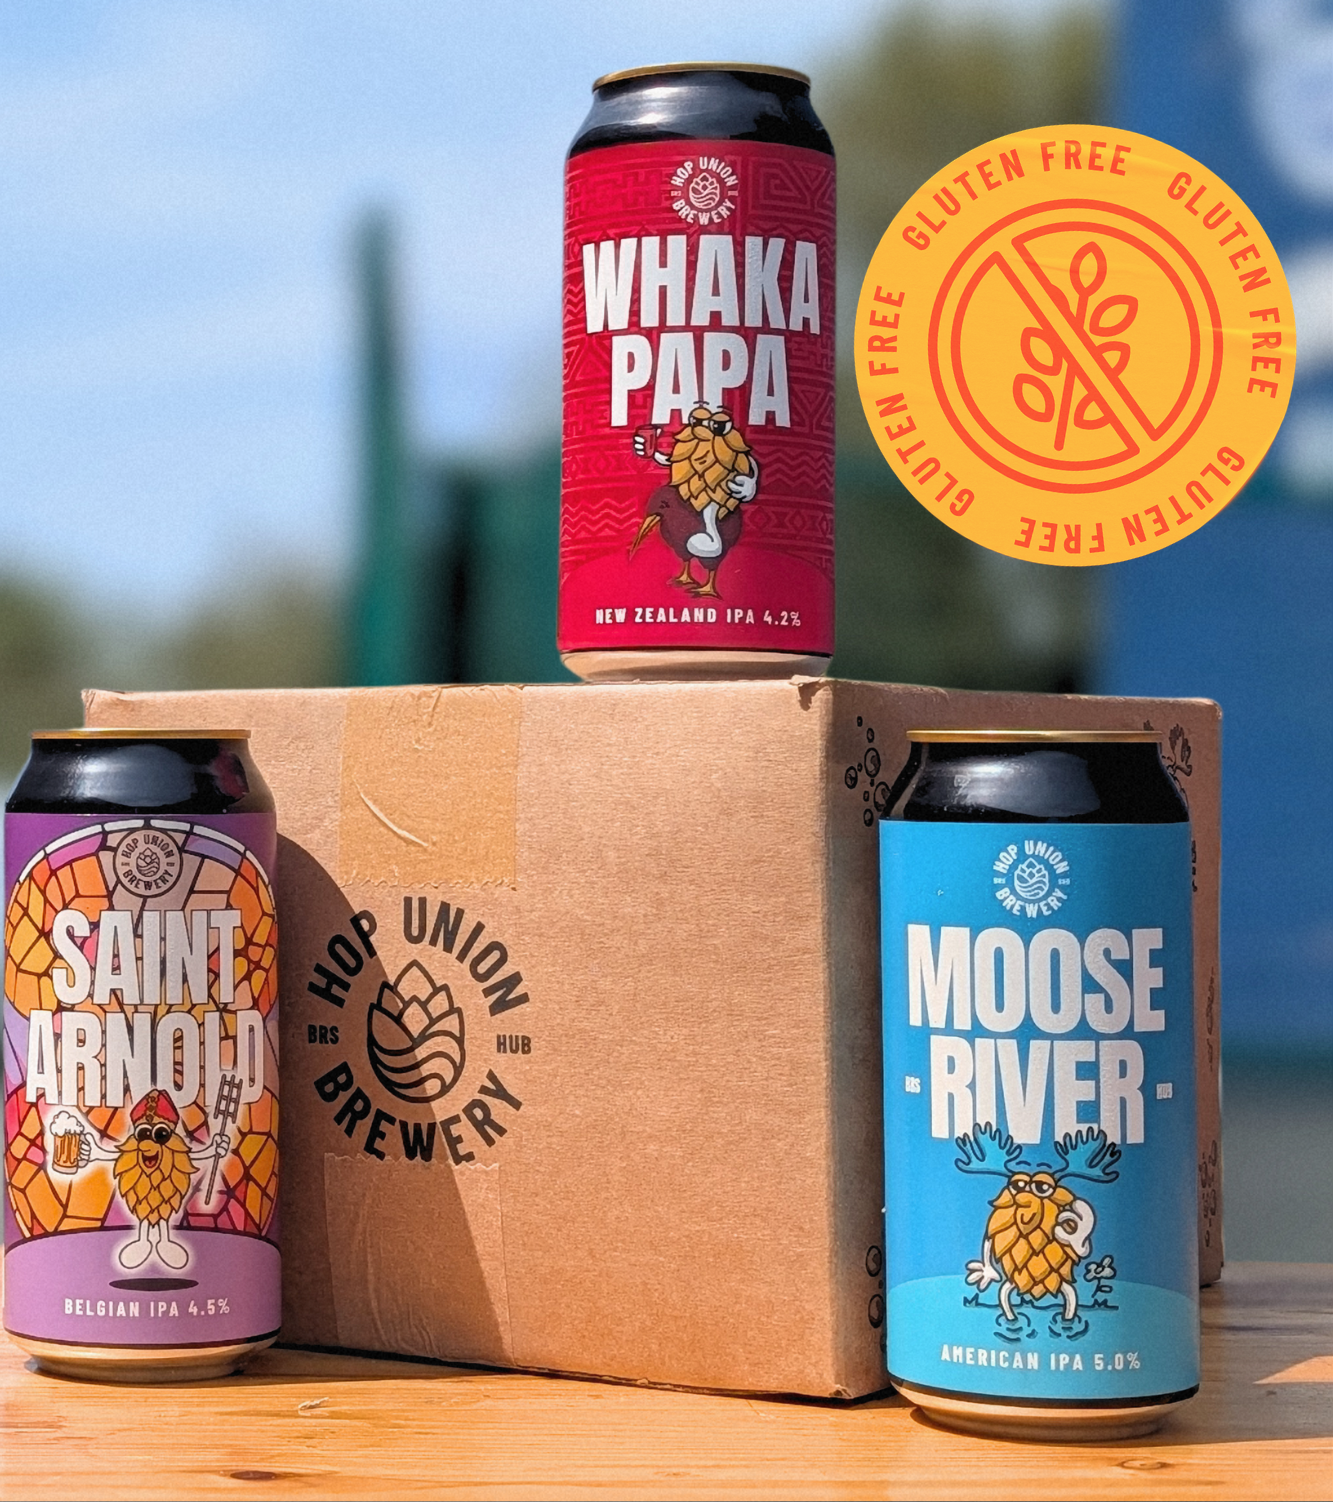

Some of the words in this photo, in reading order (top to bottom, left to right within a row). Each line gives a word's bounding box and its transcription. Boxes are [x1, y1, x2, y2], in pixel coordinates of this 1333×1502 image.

[671, 161, 693, 187] HOP
[699, 157, 738, 186] UNION
[672, 199, 735, 226] BREWERY
[582, 234, 820, 335] WHAKA
[610, 332, 791, 428] PAPA
[595, 608, 627, 624] NEW
[634, 607, 717, 623] ZEALAND
[726, 608, 755, 624] IPA
[763, 610, 801, 627] 4.2%
[121, 838, 139, 858] HOP
[143, 834, 174, 859] UNION
[993, 844, 1017, 874] HOP
[1024, 840, 1069, 874] UNION
[123, 869, 173, 890] BREWERY
[995, 887, 1067, 918] BREWERY
[51, 909, 242, 1005] SAINT
[307, 909, 377, 1008] HOP
[403, 896, 530, 1017] UNION
[907, 923, 1165, 1033] MOOSE
[307, 1024, 339, 1044] BRS
[496, 1034, 531, 1054] HUB
[25, 1009, 265, 1107] ARNOLD
[929, 1034, 1145, 1144] RIVER
[313, 1061, 522, 1166] BREWERY
[64, 1298, 139, 1317] BELGIAN
[150, 1301, 179, 1317] IPA
[188, 1297, 230, 1316] 4.5%
[941, 1344, 1039, 1370] AMERICAN
[1050, 1352, 1083, 1371] IPA
[1094, 1352, 1141, 1371] 5.0%
